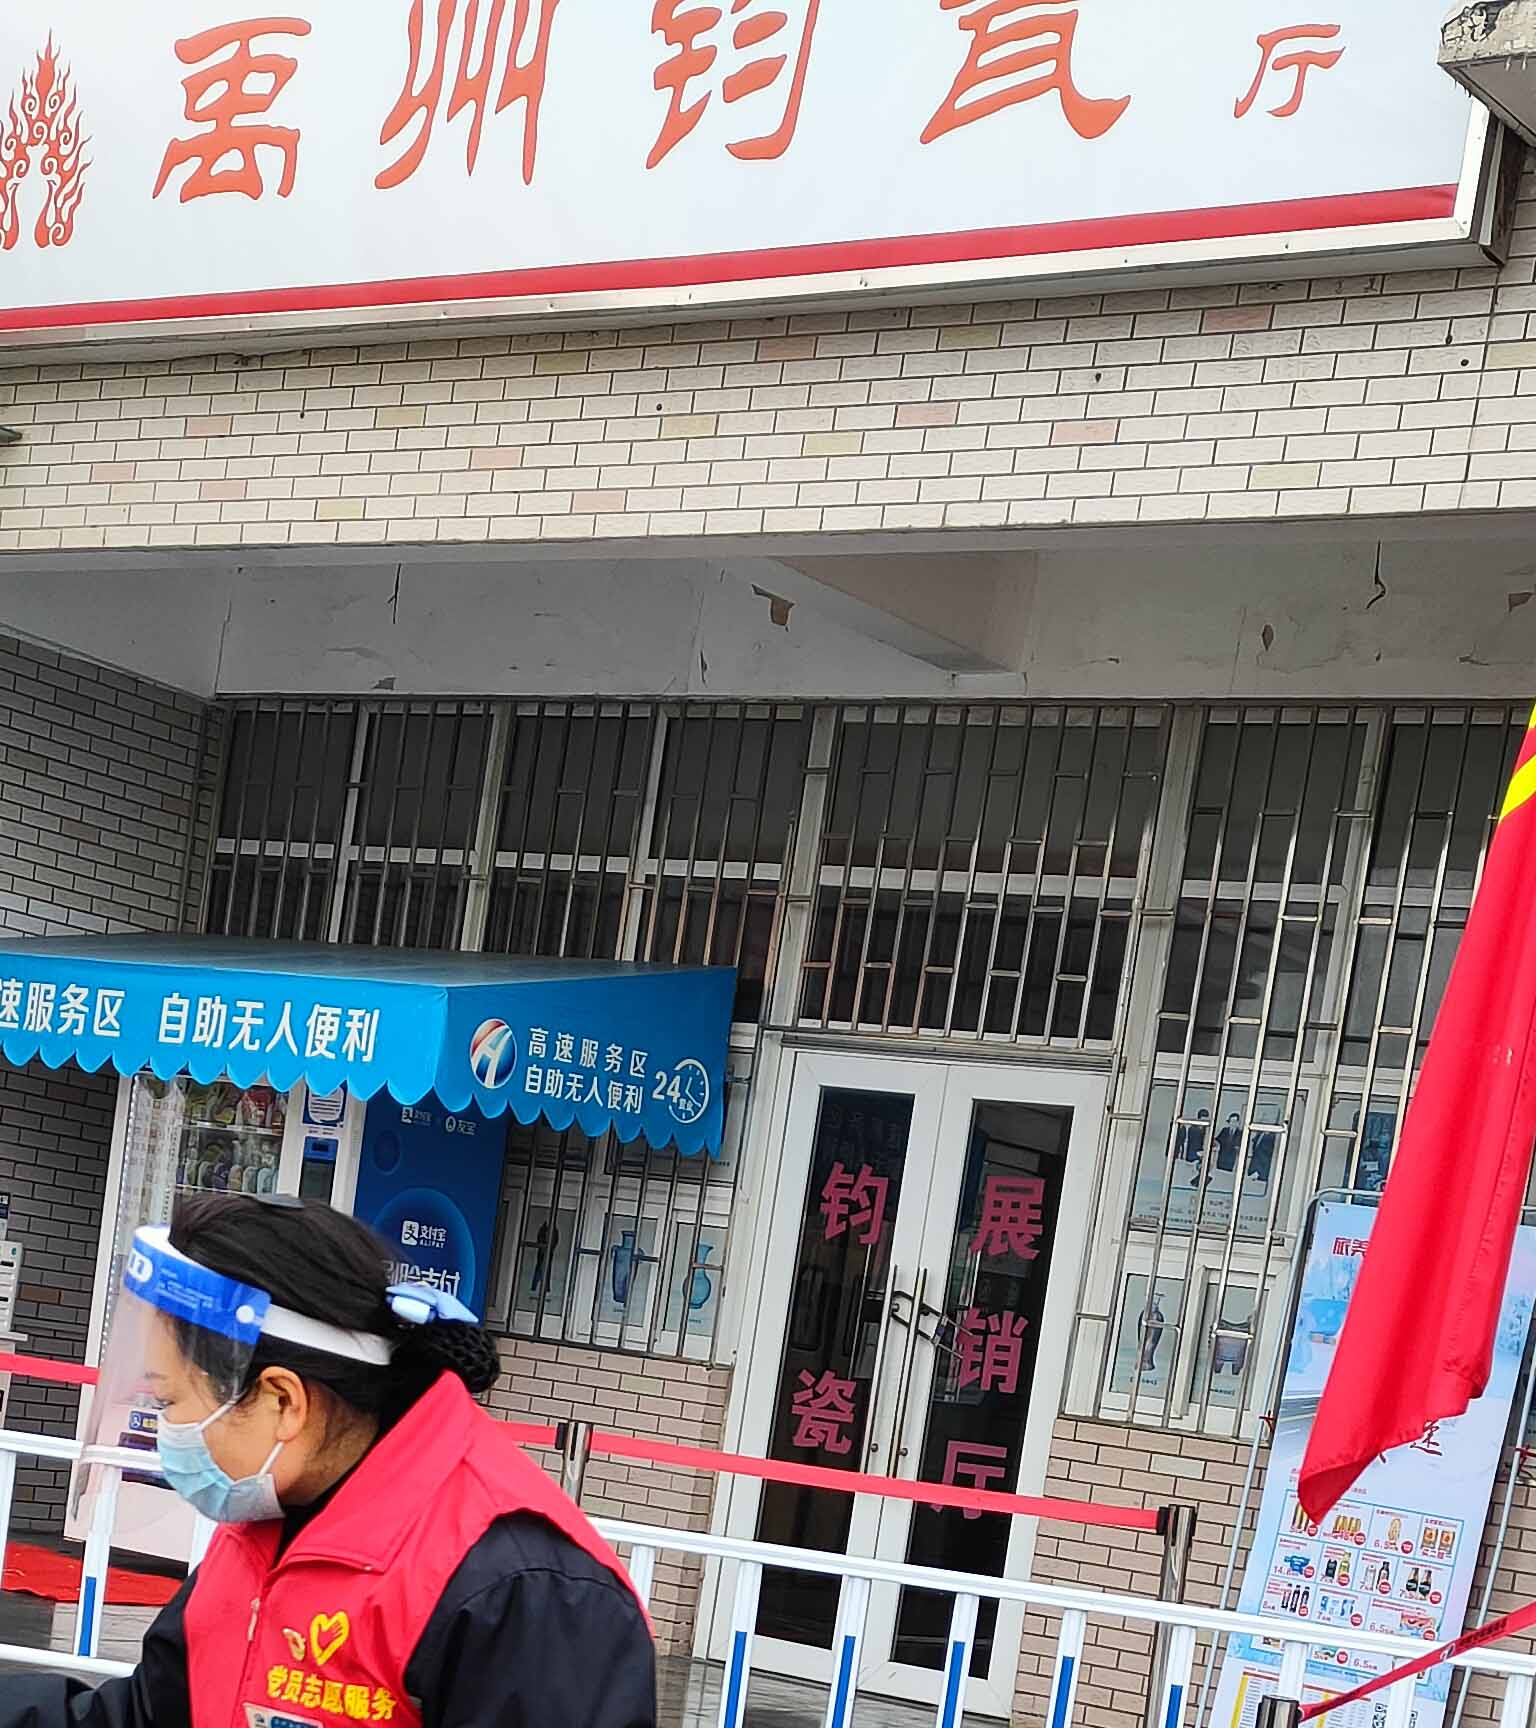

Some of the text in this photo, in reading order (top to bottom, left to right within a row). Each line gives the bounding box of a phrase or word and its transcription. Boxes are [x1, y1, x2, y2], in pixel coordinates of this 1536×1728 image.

[158, 991, 381, 1064] 自助无人便利
[528, 1027, 649, 1079] 高速服务区
[524, 1064, 681, 1115] 自助无人便利 24
[267, 1664, 398, 1722] 党员志愿服务
